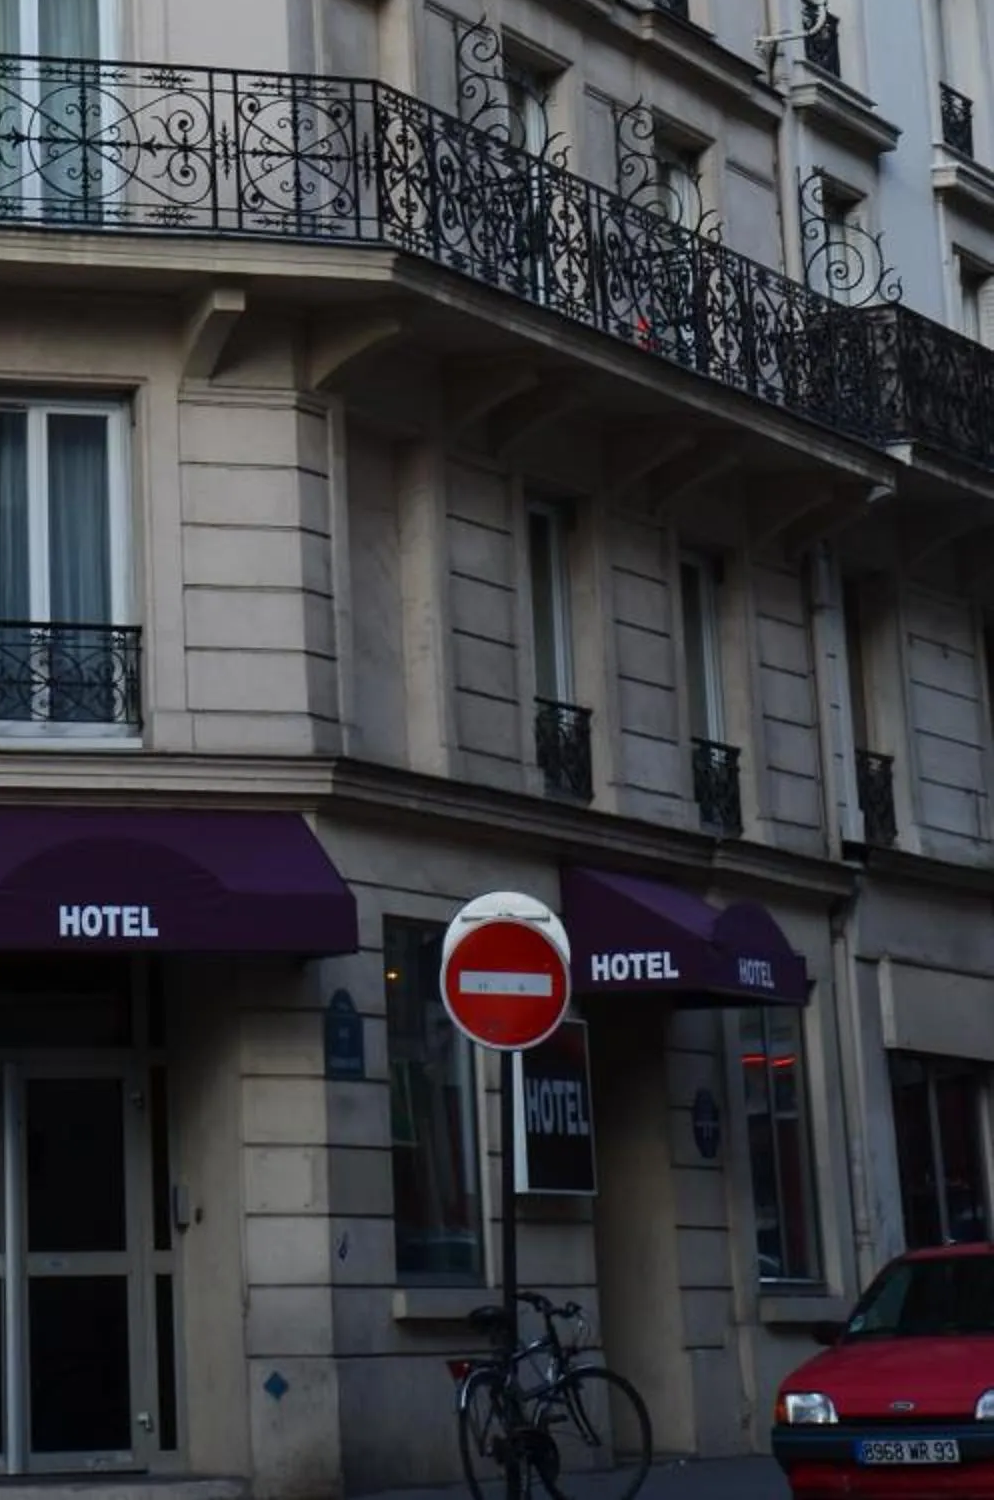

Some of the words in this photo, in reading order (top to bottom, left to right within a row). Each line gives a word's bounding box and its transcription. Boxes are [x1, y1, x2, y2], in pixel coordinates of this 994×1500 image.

[58, 904, 159, 938] HOTEL
[590, 951, 679, 981] HOTEL
[737, 957, 775, 988] HOTEL
[526, 1078, 589, 1135] HOTEL
[933, 1442, 956, 1461] 93
